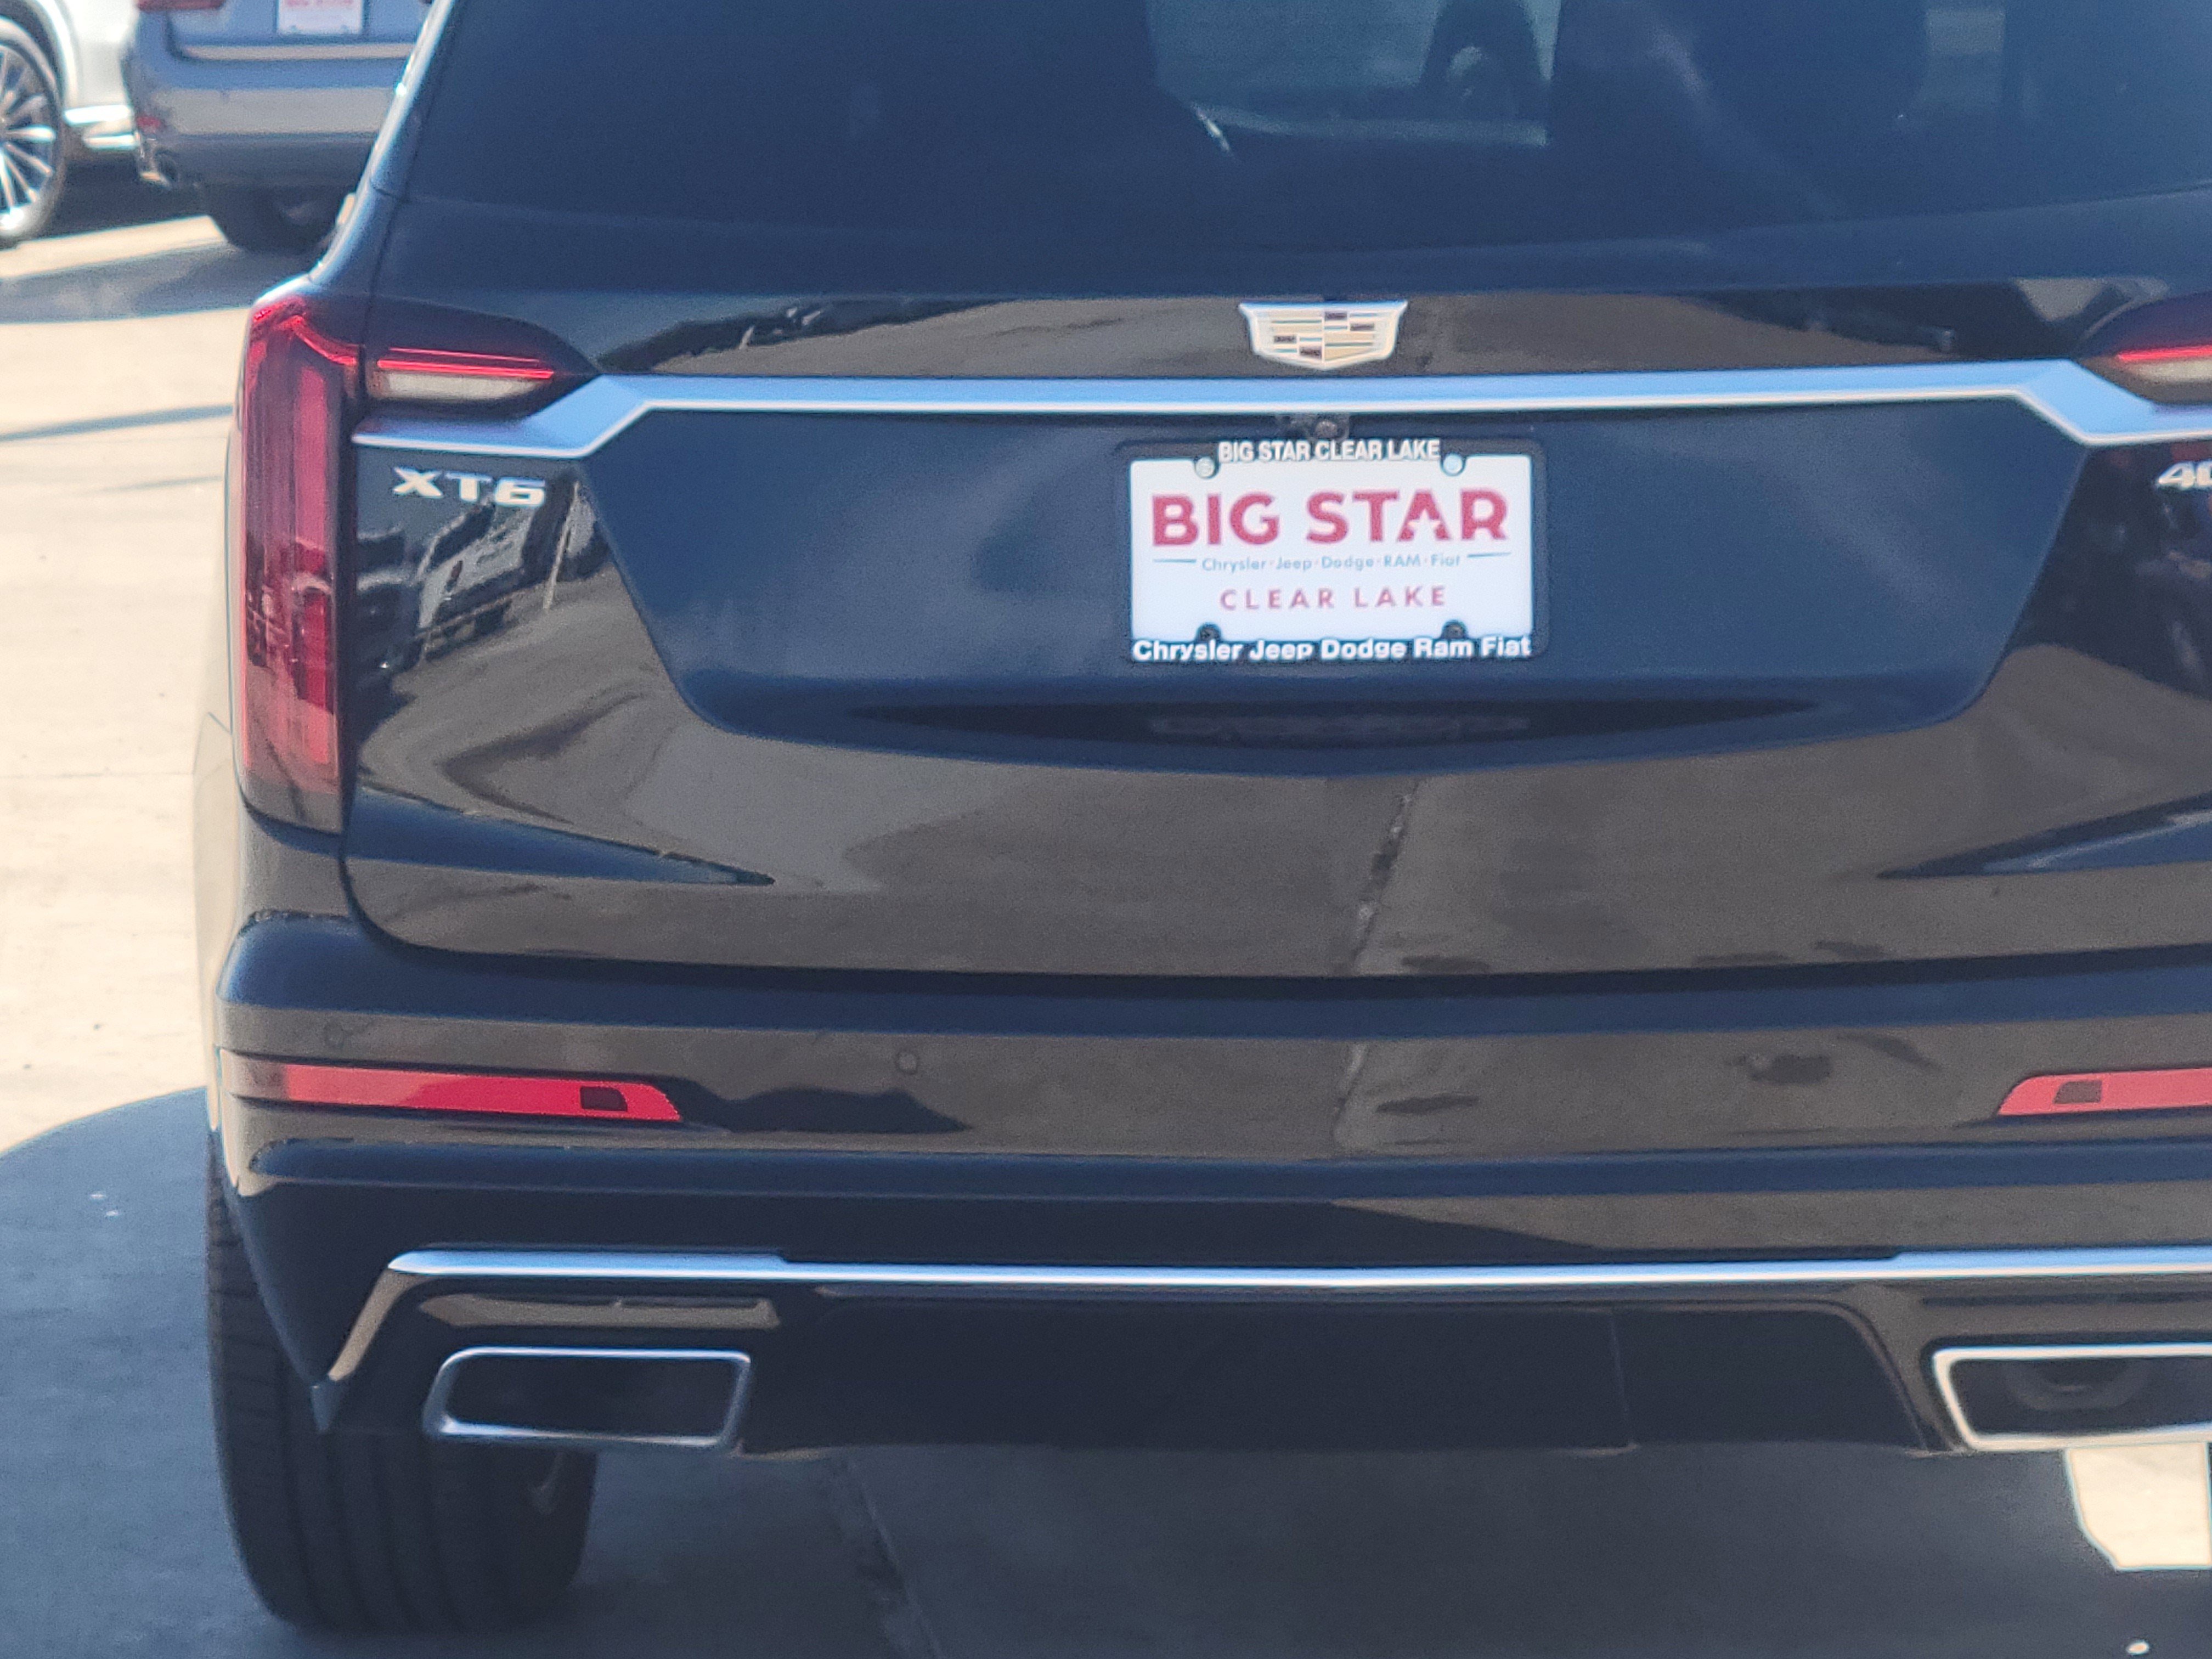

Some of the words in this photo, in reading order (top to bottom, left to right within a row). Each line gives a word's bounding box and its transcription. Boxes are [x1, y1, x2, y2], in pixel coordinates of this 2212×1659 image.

[1218, 441, 1254, 461] BIG
[1259, 441, 1311, 461] STAR
[1314, 440, 1384, 461] CLEAR
[1387, 439, 1441, 461] LAKE
[392, 466, 546, 507] XT6
[1152, 491, 1280, 546] BIG
[1305, 487, 1509, 544] STAR
[1220, 588, 1335, 611] CLEAR
[1354, 585, 1446, 608] LAKE
[1132, 640, 1242, 662] Chrysler
[1249, 640, 1314, 661] Jeep
[1321, 638, 1406, 660] Dodge
[1414, 636, 1473, 658] Ram
[1480, 635, 1532, 657] Fiat
